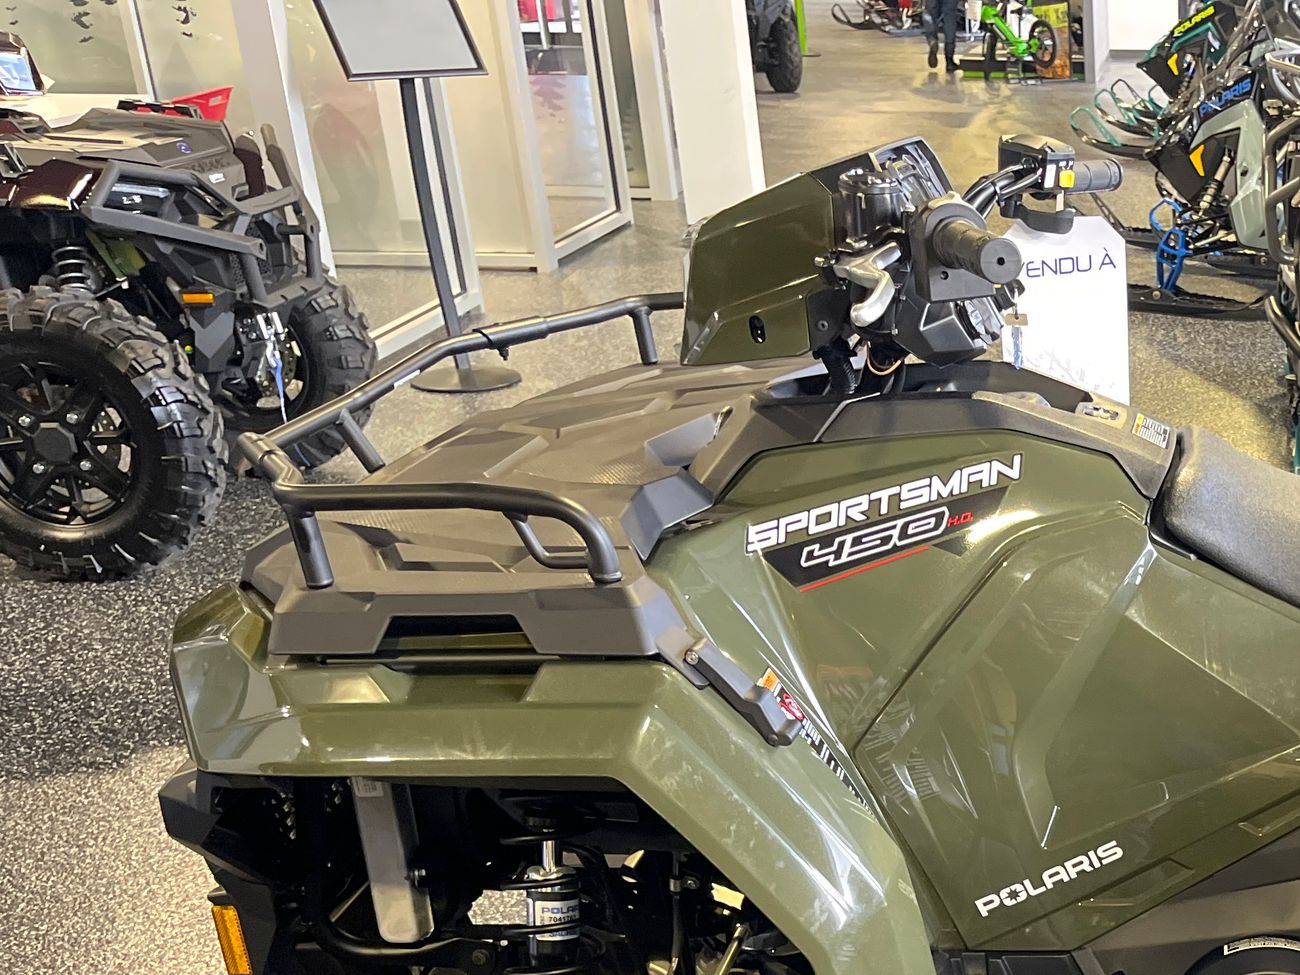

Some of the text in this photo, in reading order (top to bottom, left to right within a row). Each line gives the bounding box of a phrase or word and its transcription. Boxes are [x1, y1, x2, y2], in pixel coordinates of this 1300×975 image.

[1021, 247, 1117, 278] ENDU À
[745, 452, 1023, 555] SPORTSMAN
[800, 506, 974, 568] 450 H.O.
[974, 840, 1124, 918] POLARIS
